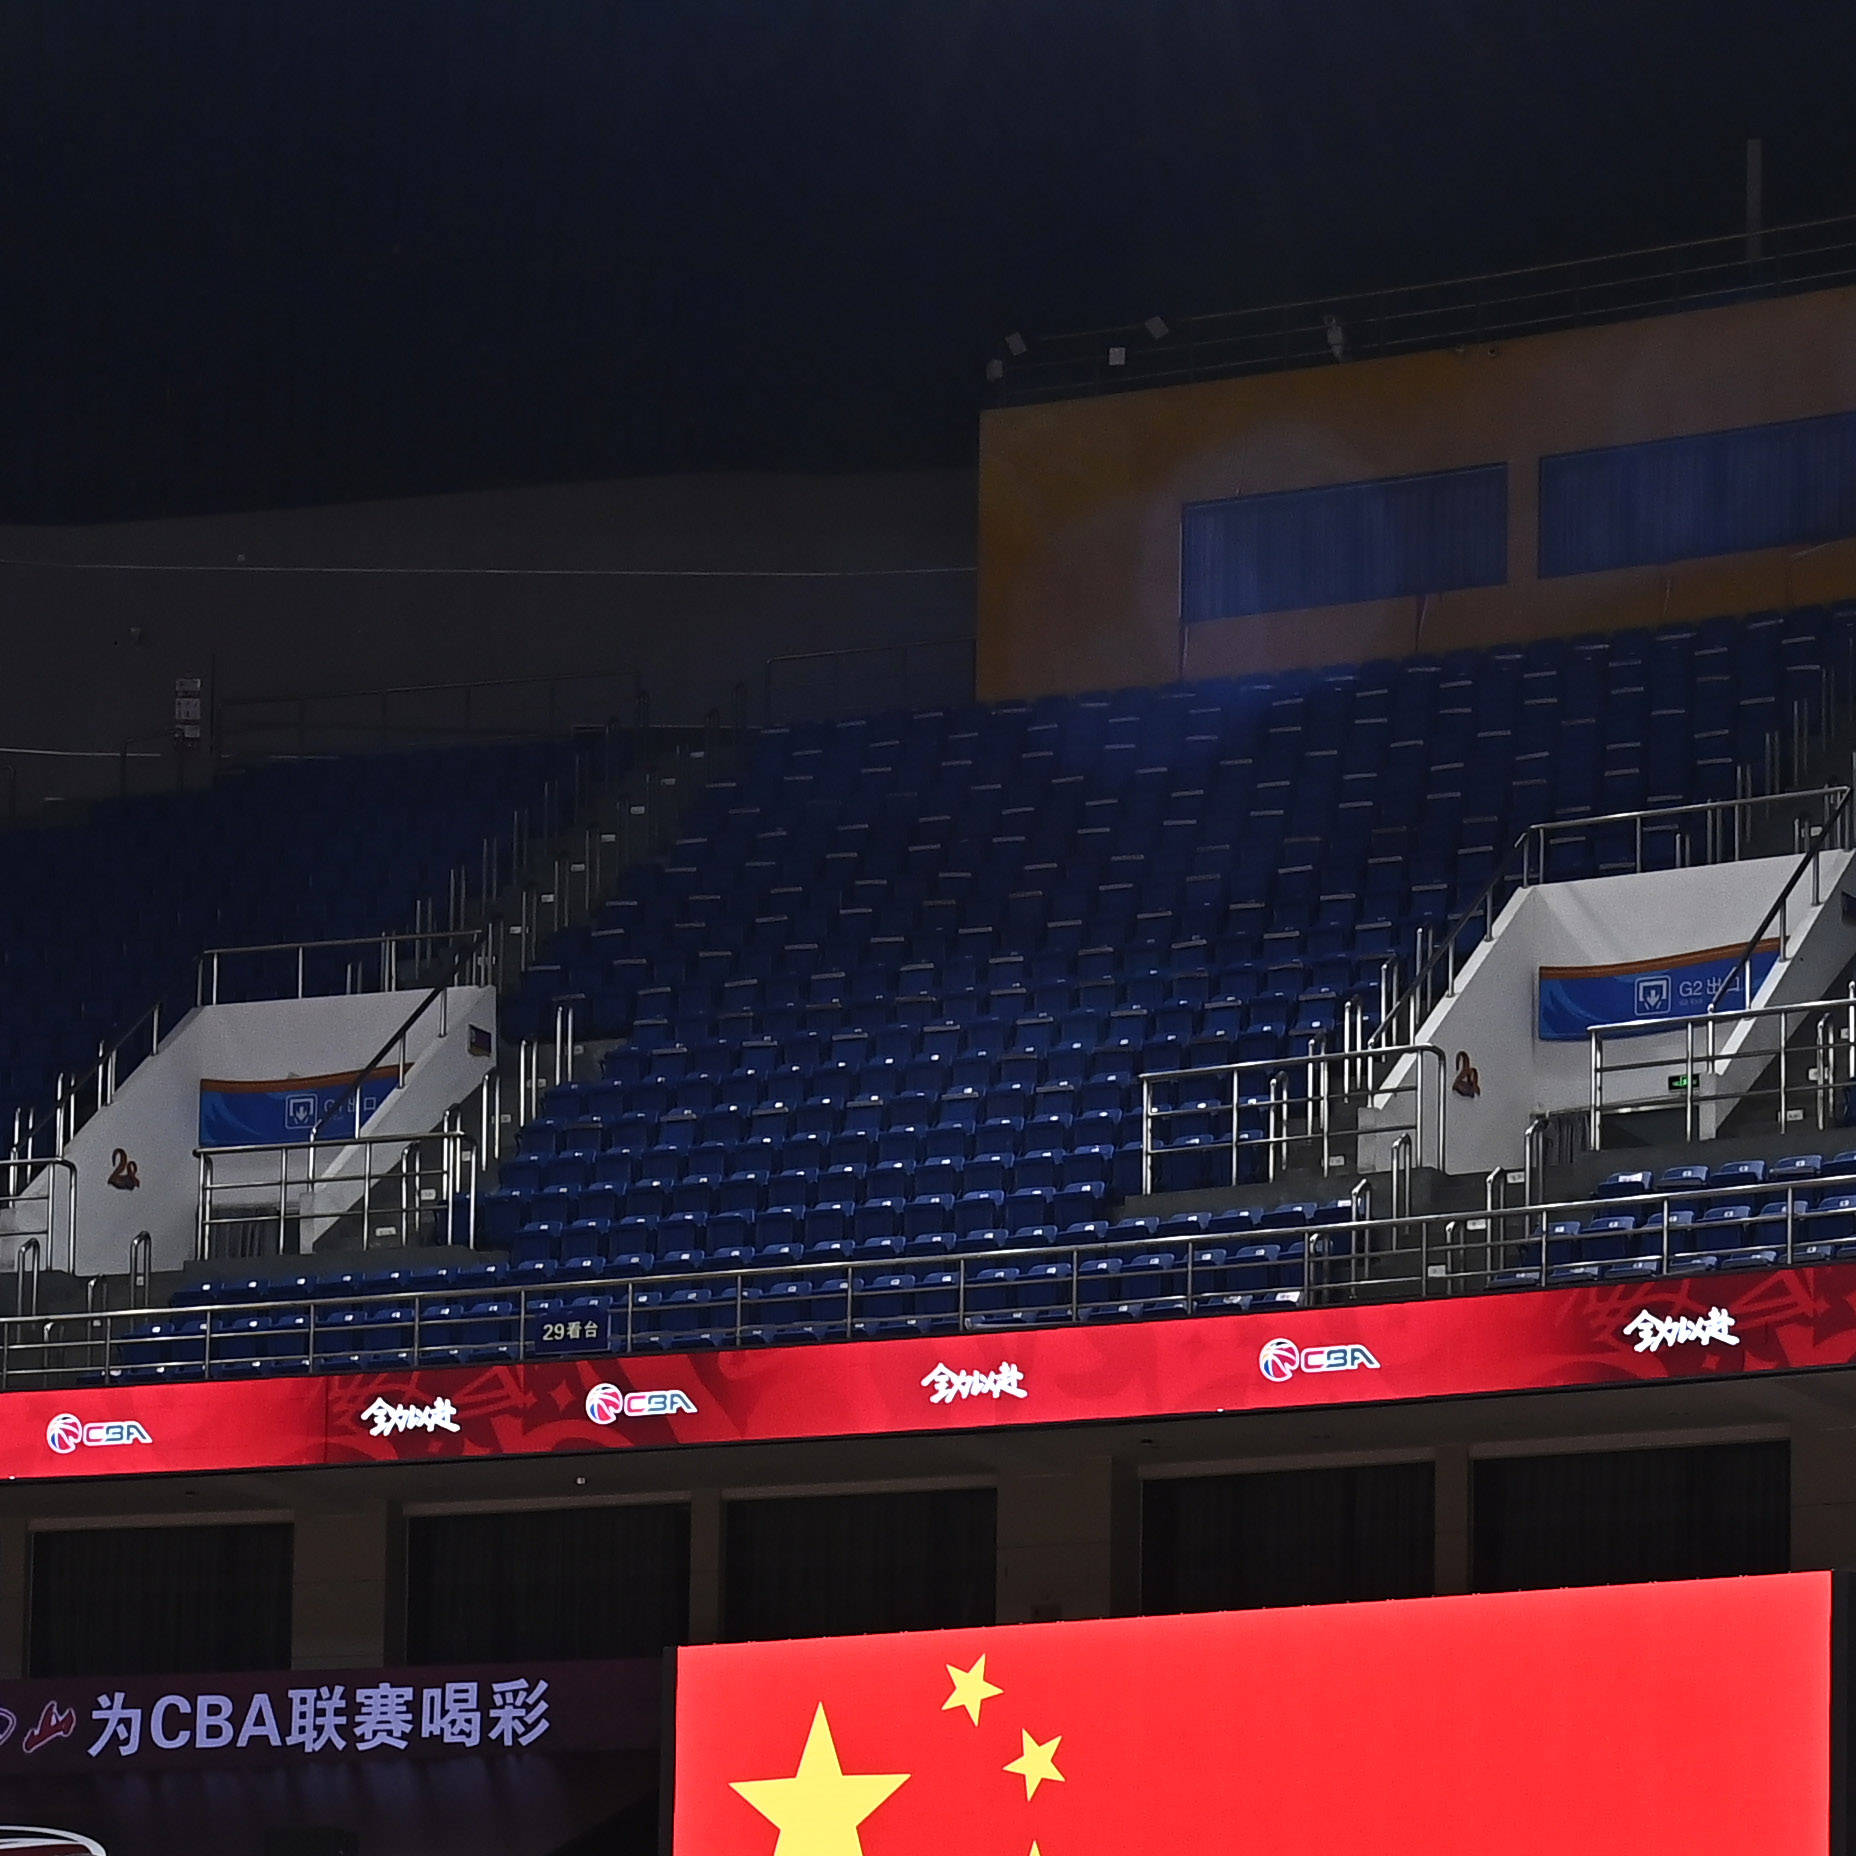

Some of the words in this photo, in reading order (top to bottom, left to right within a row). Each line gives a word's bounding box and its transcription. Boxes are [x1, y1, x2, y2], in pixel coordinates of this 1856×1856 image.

[542, 1320, 598, 1342] 29看台
[1301, 1343, 1380, 1373] CBA
[622, 1389, 697, 1417] CBA
[81, 1421, 152, 1446] CBA
